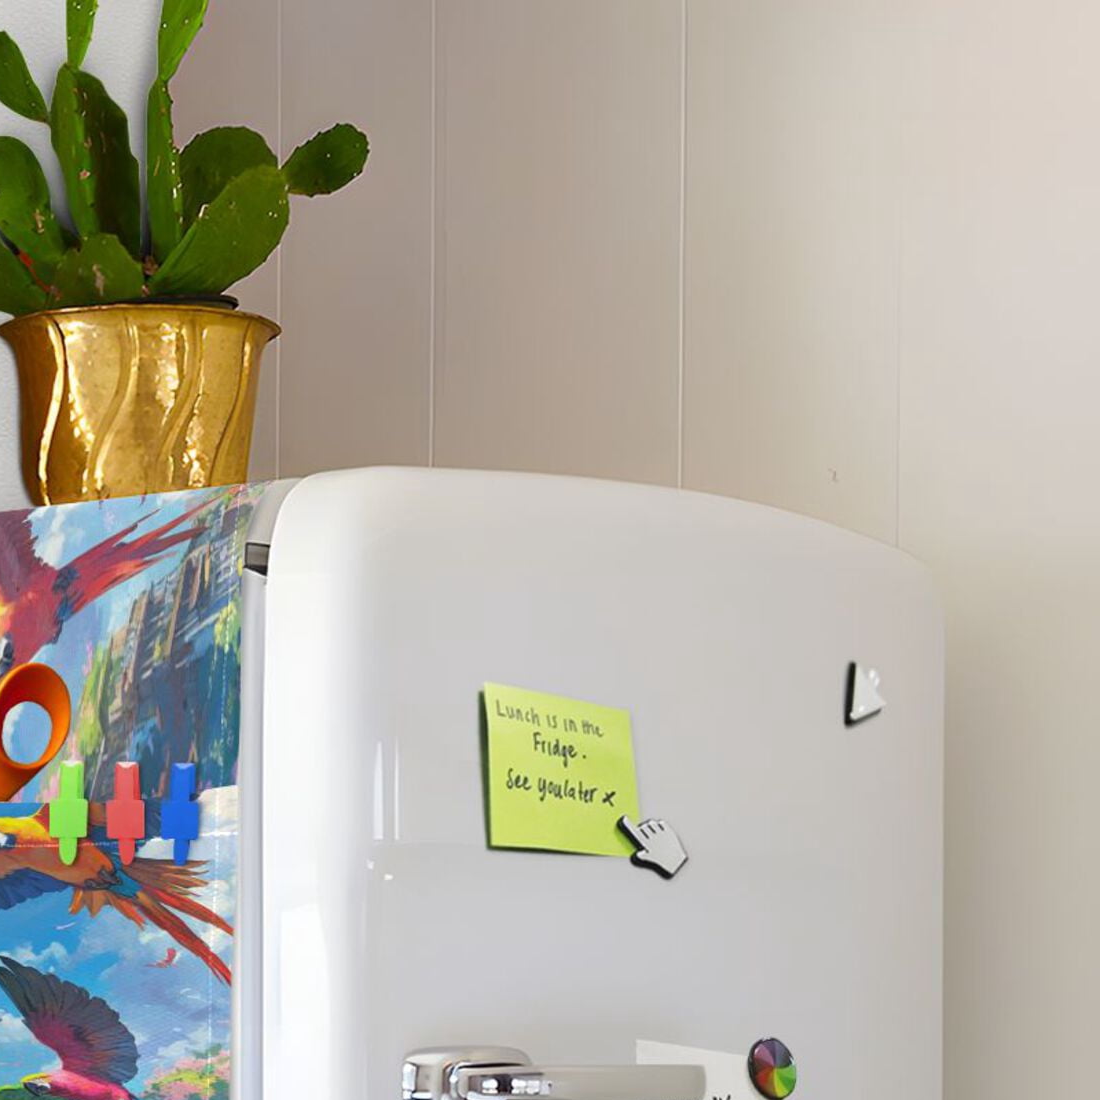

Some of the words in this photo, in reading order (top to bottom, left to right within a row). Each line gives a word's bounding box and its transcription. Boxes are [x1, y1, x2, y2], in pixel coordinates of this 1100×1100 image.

[496, 699, 540, 728] Lunch
[547, 714, 557, 729] is
[564, 717, 578, 733] in
[582, 719, 604, 738] the
[506, 767, 532, 791] See
